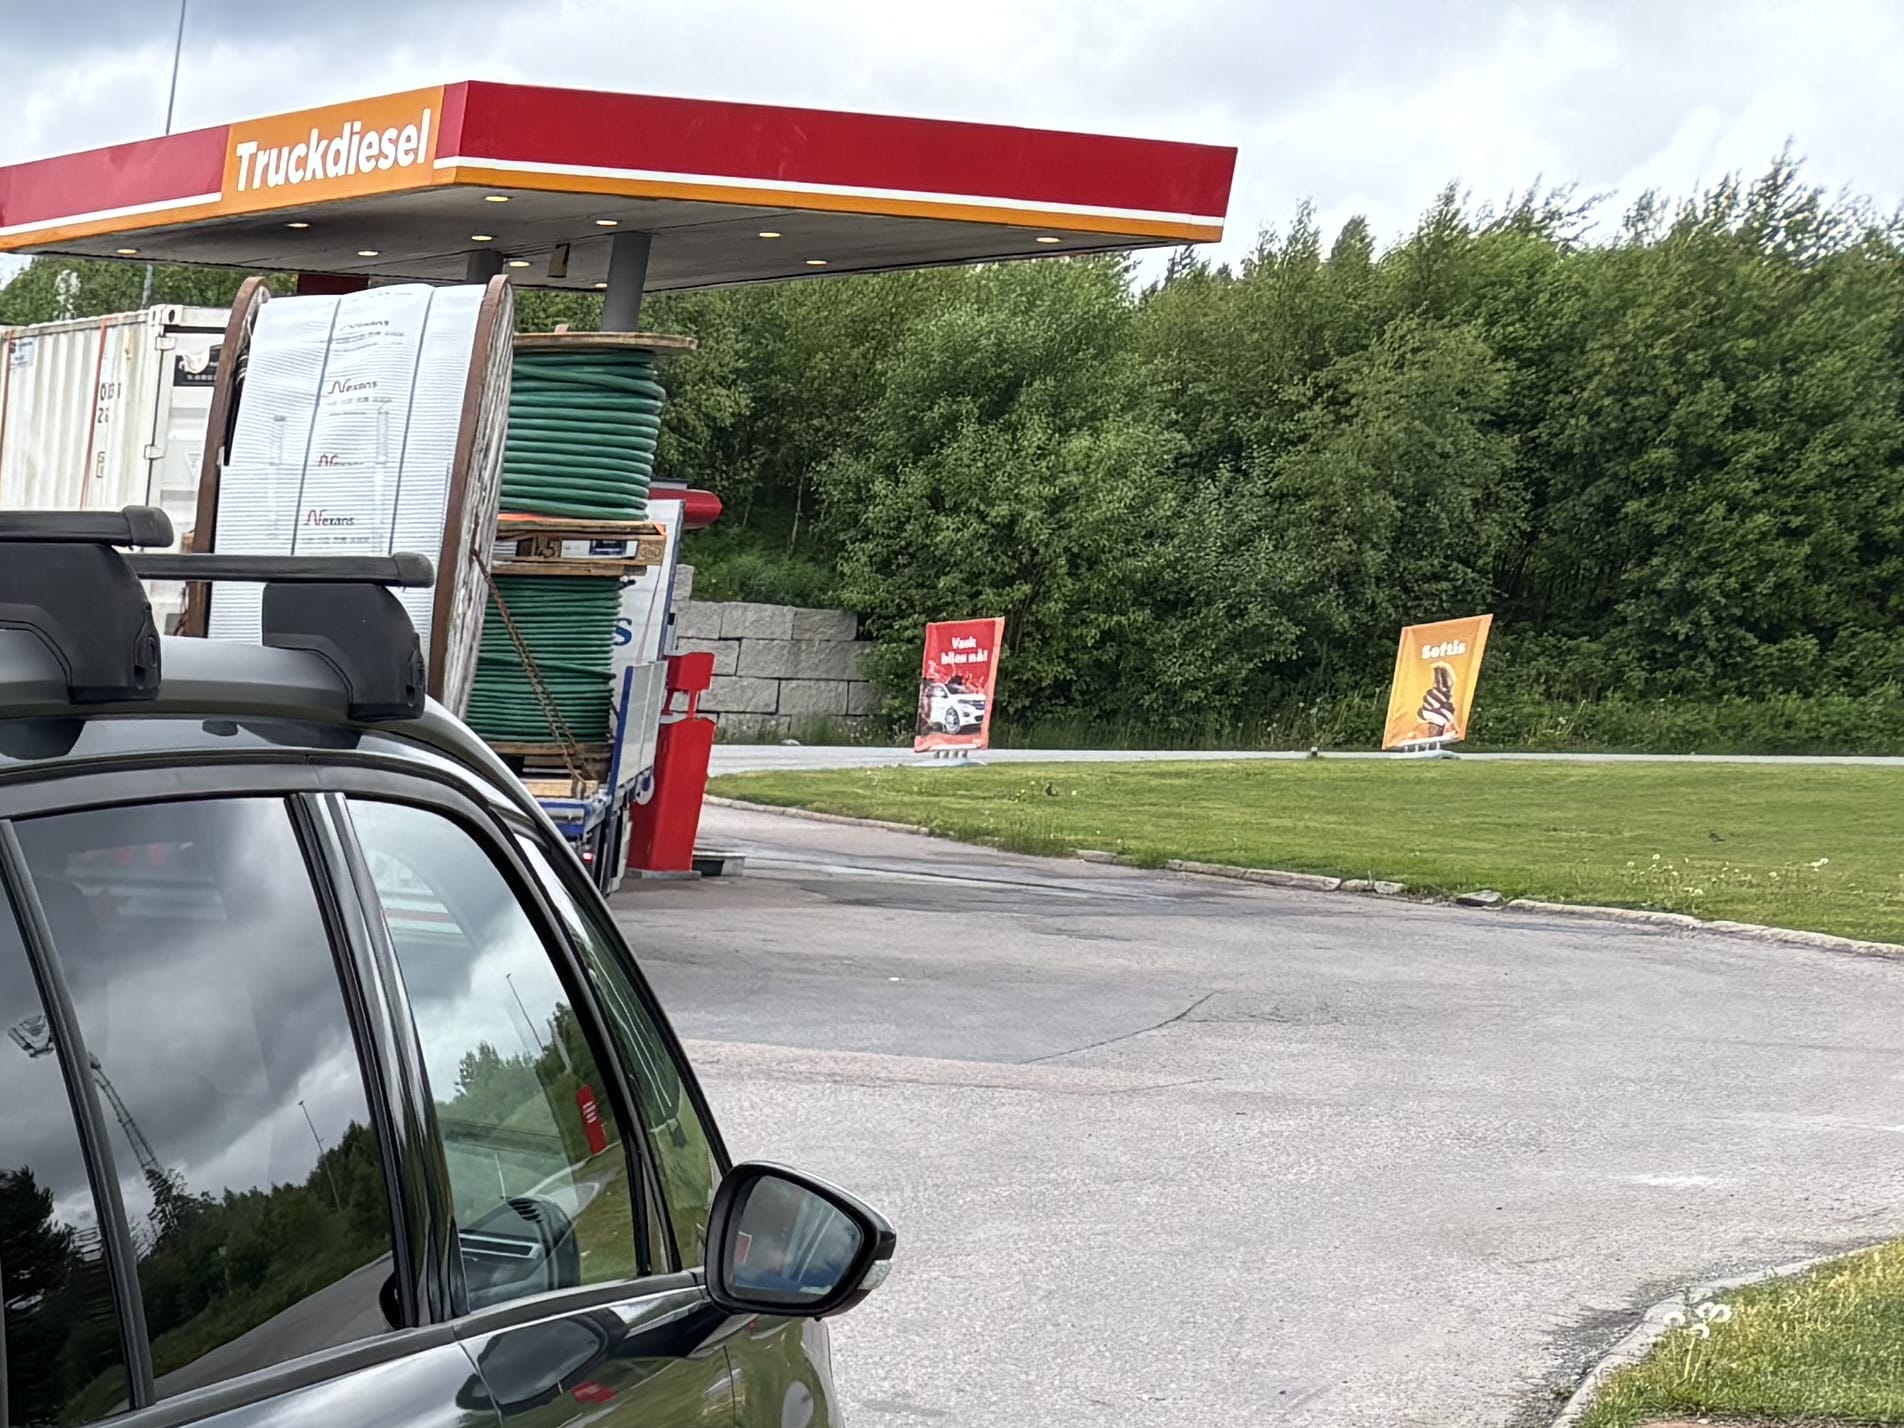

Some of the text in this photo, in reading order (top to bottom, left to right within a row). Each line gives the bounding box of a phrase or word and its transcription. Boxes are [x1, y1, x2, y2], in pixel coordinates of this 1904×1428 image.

[236, 108, 431, 191] Truckdiesel
[302, 509, 355, 526] Nexans
[951, 636, 977, 649] Vask
[1421, 640, 1466, 659] Softis
[940, 651, 967, 665] bilen
